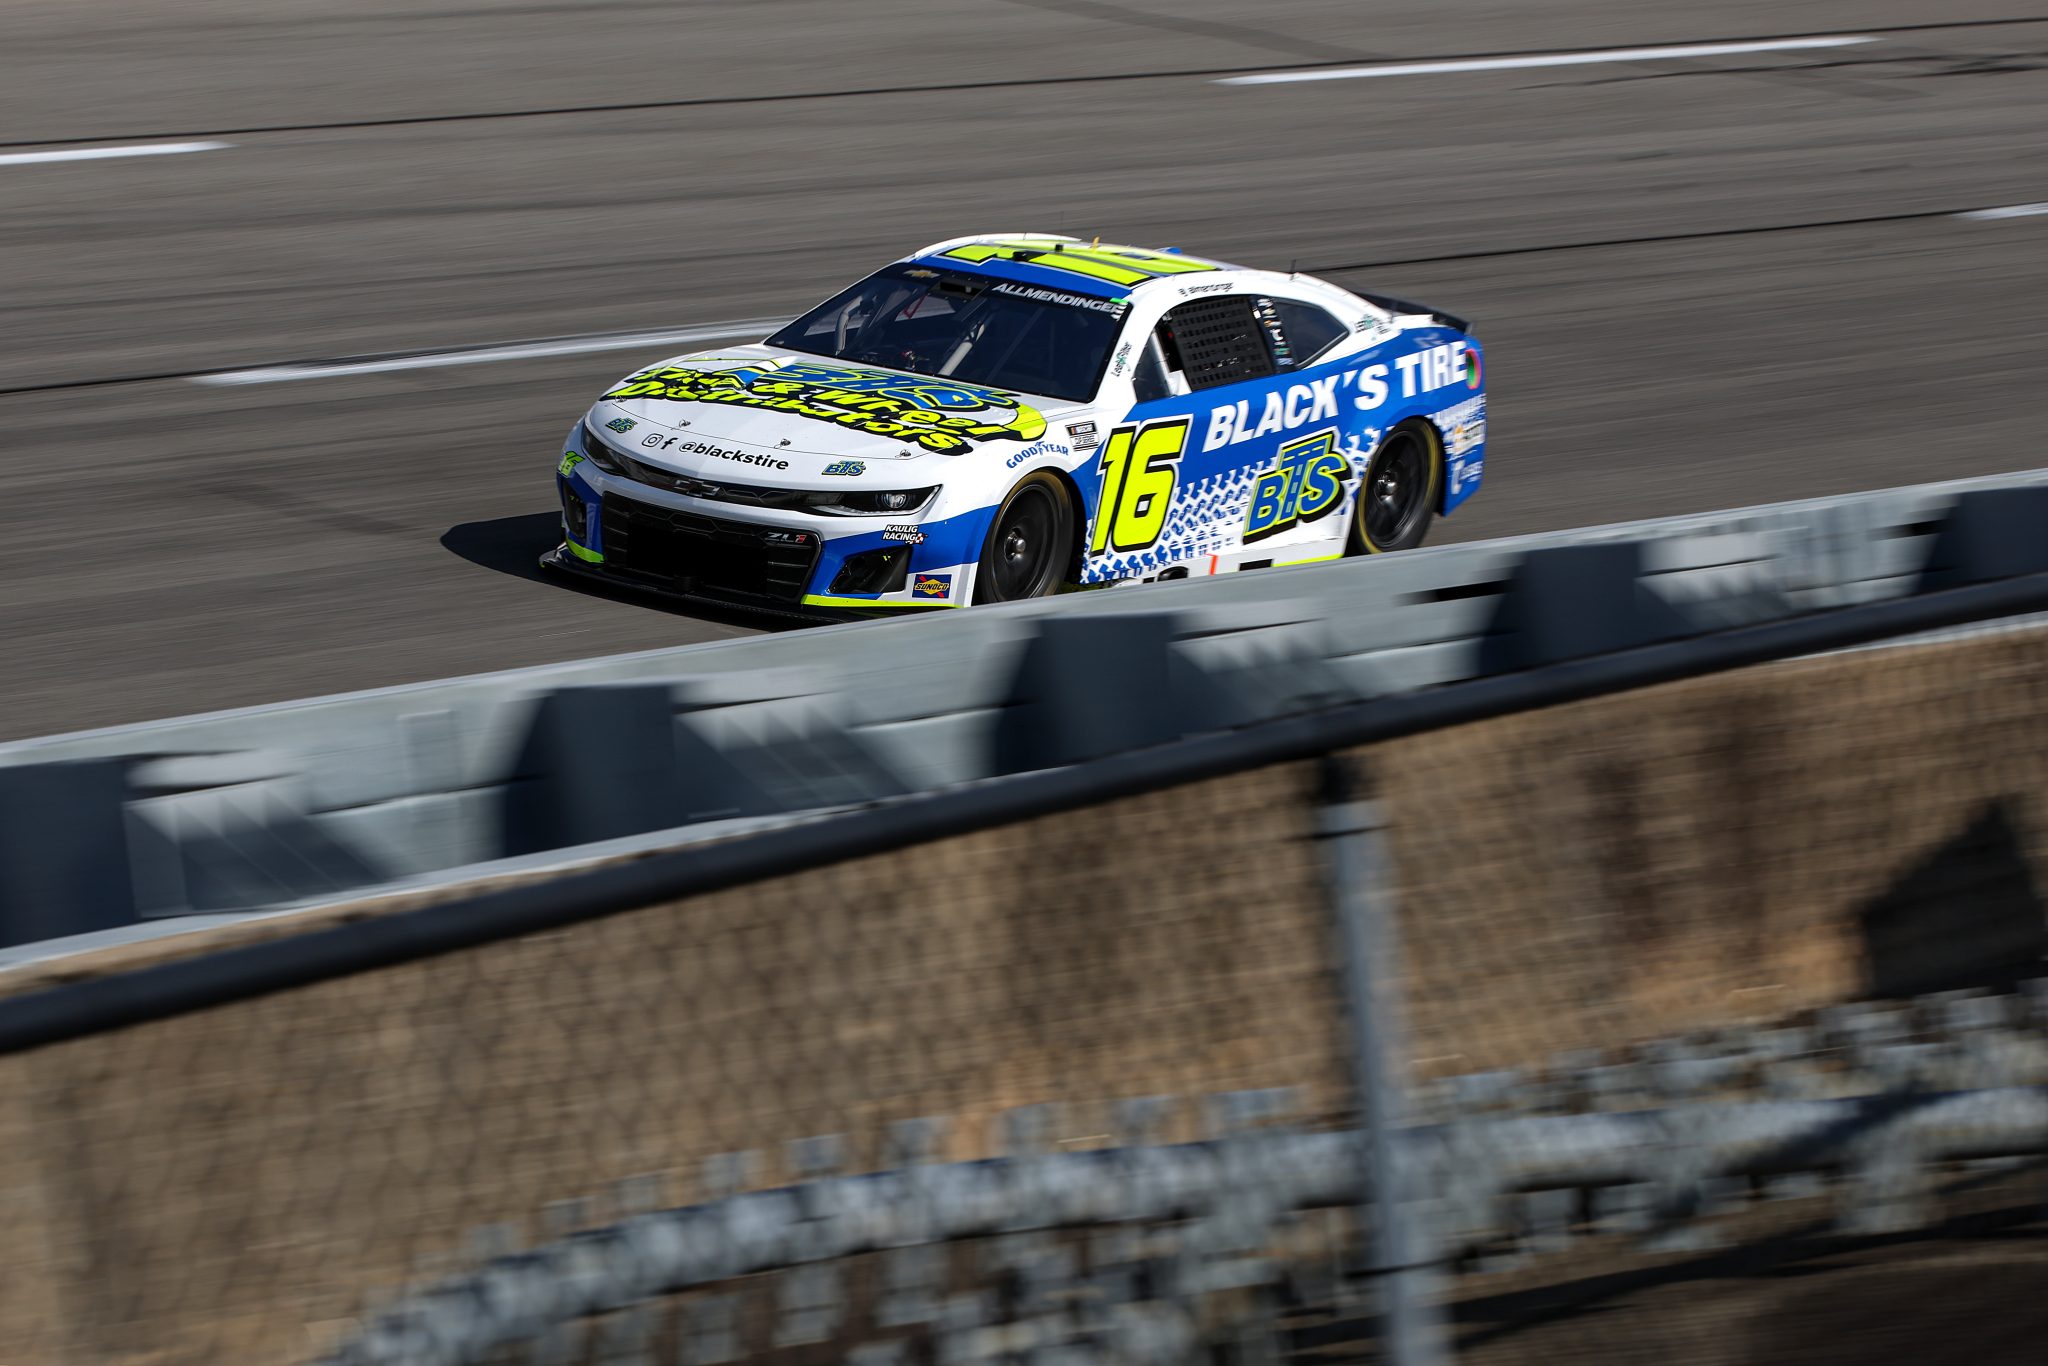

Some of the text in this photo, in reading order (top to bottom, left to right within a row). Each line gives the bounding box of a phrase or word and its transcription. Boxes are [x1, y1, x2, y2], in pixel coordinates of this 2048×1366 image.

[811, 388, 1009, 437] Wheel
[1202, 364, 1389, 452] BLACK'S
[1395, 340, 1468, 398] TIRE
[600, 380, 968, 454] Distributors
[679, 441, 790, 470] @blackstire
[821, 460, 868, 476] BTS
[1090, 416, 1189, 557] 16
[1243, 432, 1350, 544] BTS
[882, 532, 916, 542] RACING
[885, 524, 919, 534] KAULIG
[916, 582, 950, 591] SUNOCO
